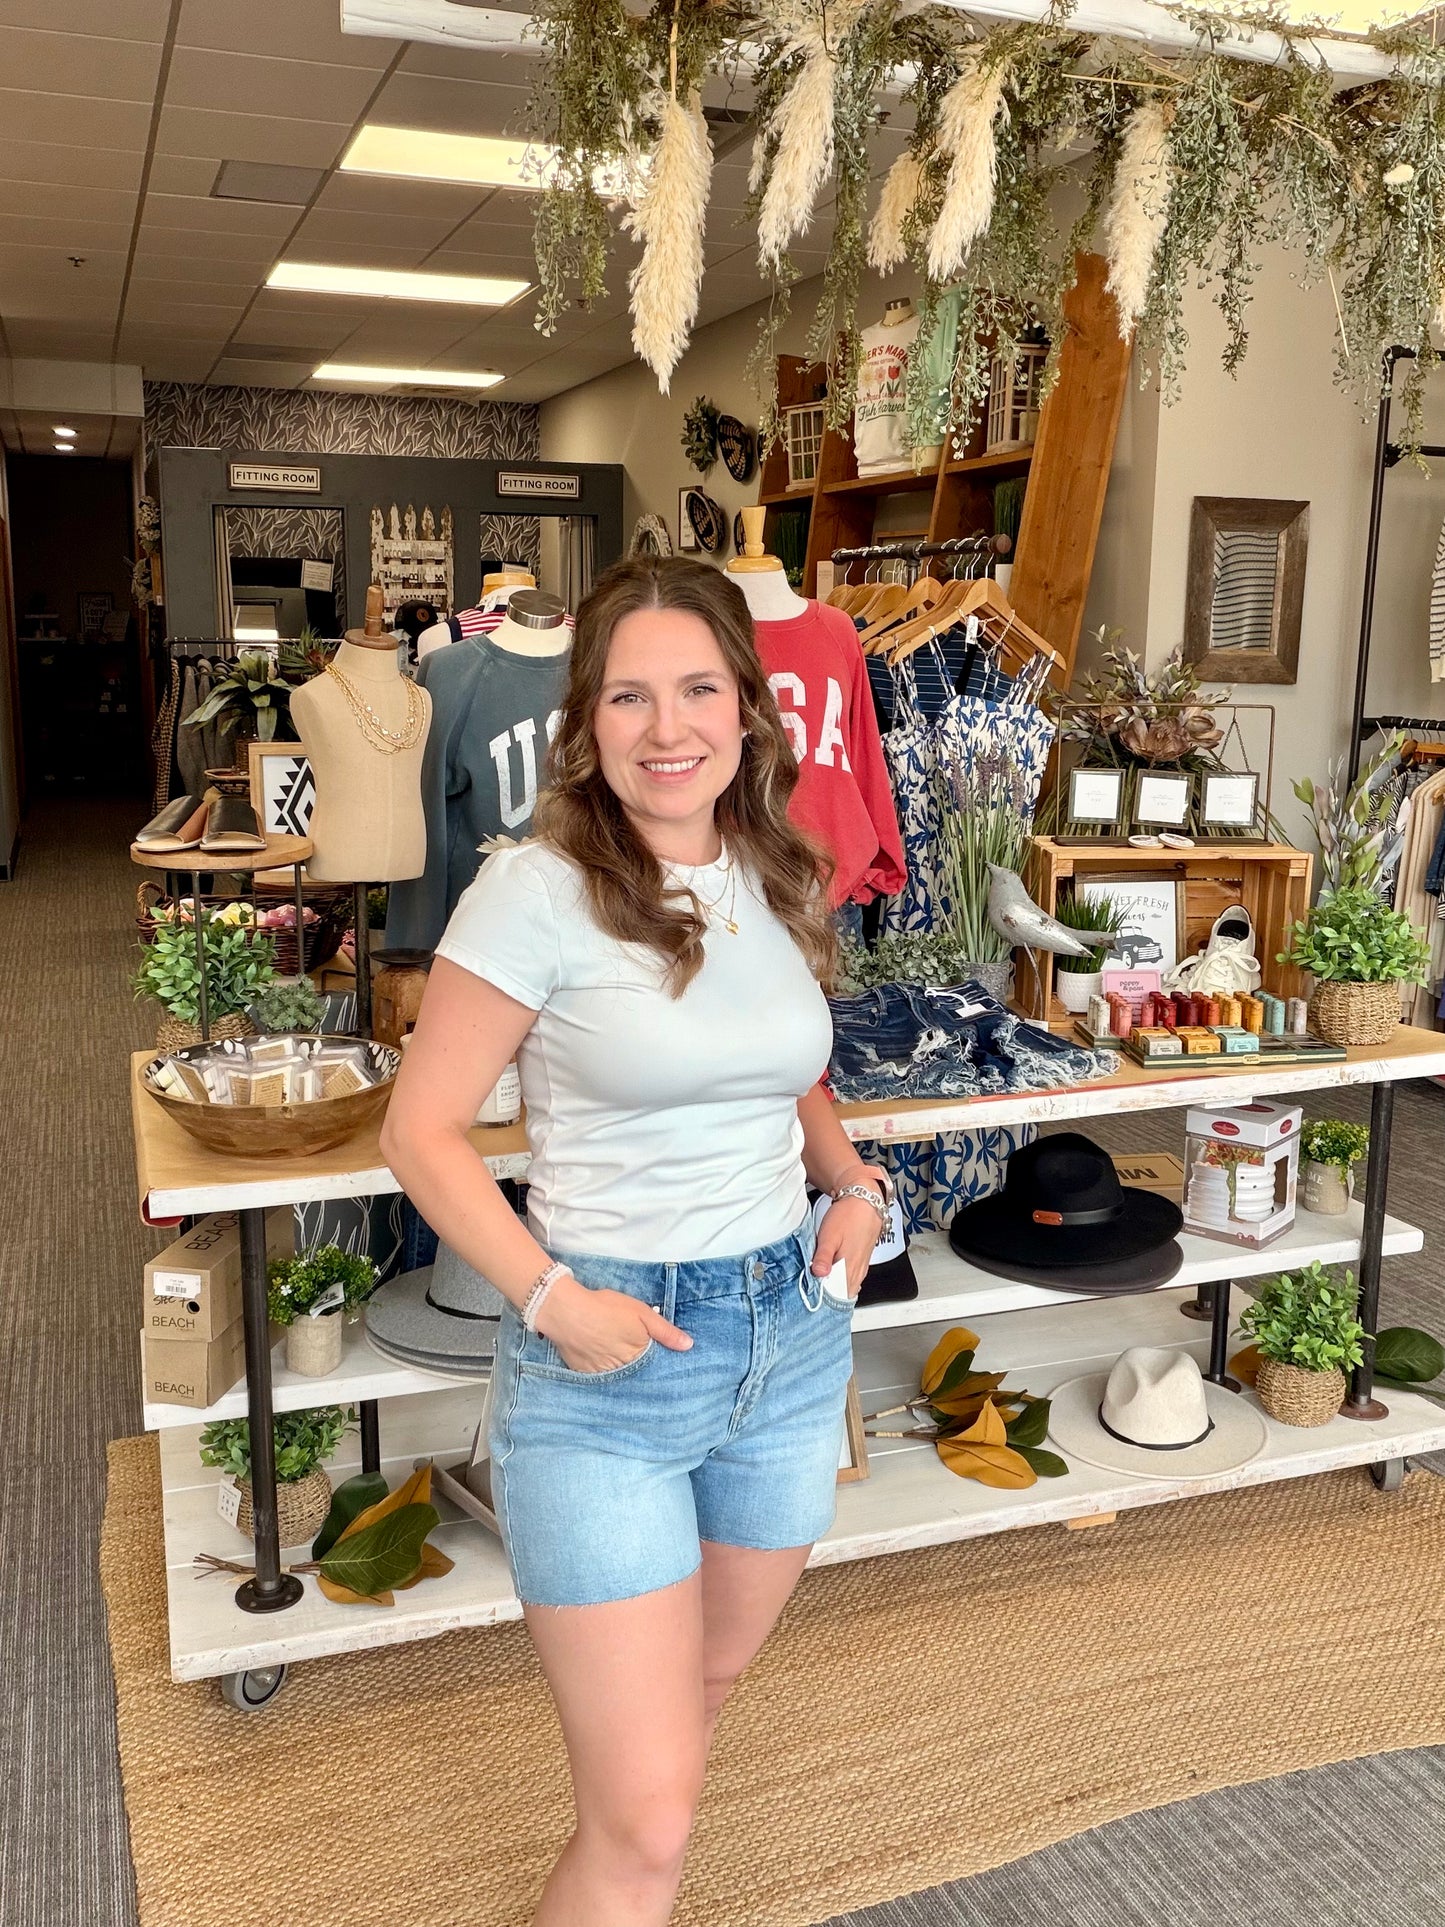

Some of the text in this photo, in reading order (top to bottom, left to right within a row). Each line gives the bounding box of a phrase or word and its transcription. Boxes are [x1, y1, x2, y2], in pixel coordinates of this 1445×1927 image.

[867, 345, 884, 360] ER'S
[236, 471, 315, 484] FITTING ROOM
[503, 479, 574, 491] FITTING ROOM
[768, 672, 853, 776] SA
[1137, 896, 1170, 912] FRESH
[152, 1316, 195, 1329] BEACH
[154, 1381, 195, 1396] BEACH
